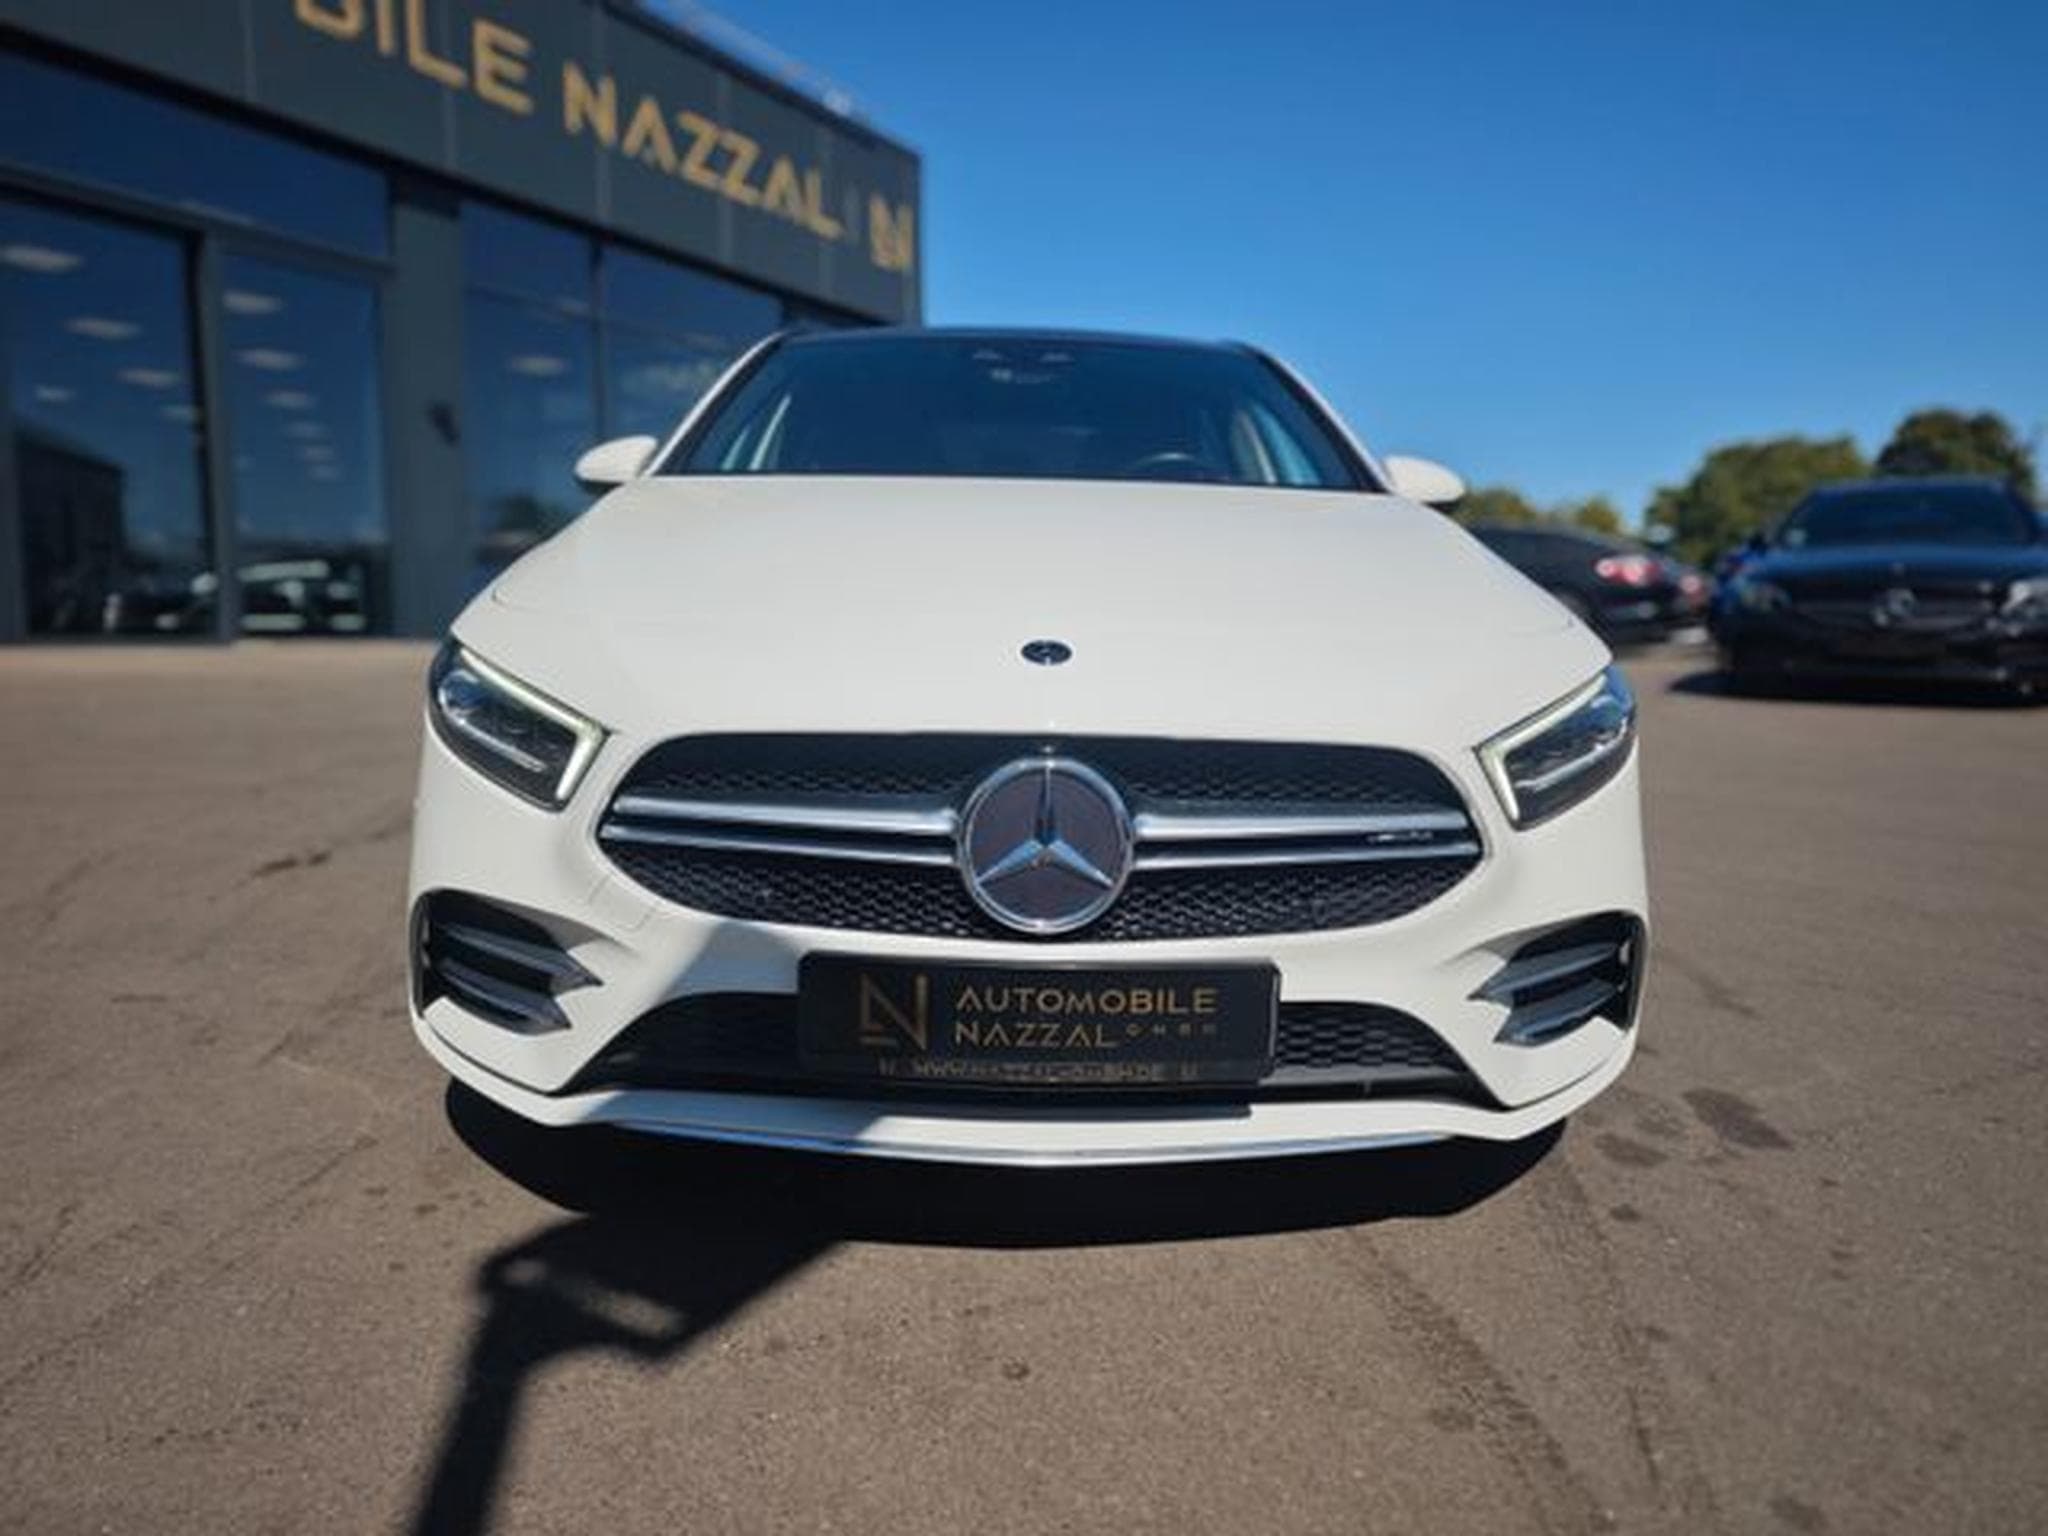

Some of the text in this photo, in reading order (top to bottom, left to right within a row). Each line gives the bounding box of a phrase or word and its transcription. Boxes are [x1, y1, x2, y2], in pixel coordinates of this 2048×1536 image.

[562, 60, 843, 241] NAZZAL
[954, 986, 1220, 1015] AUTOMOBILE
[954, 1022, 1120, 1049] NAZZAL
